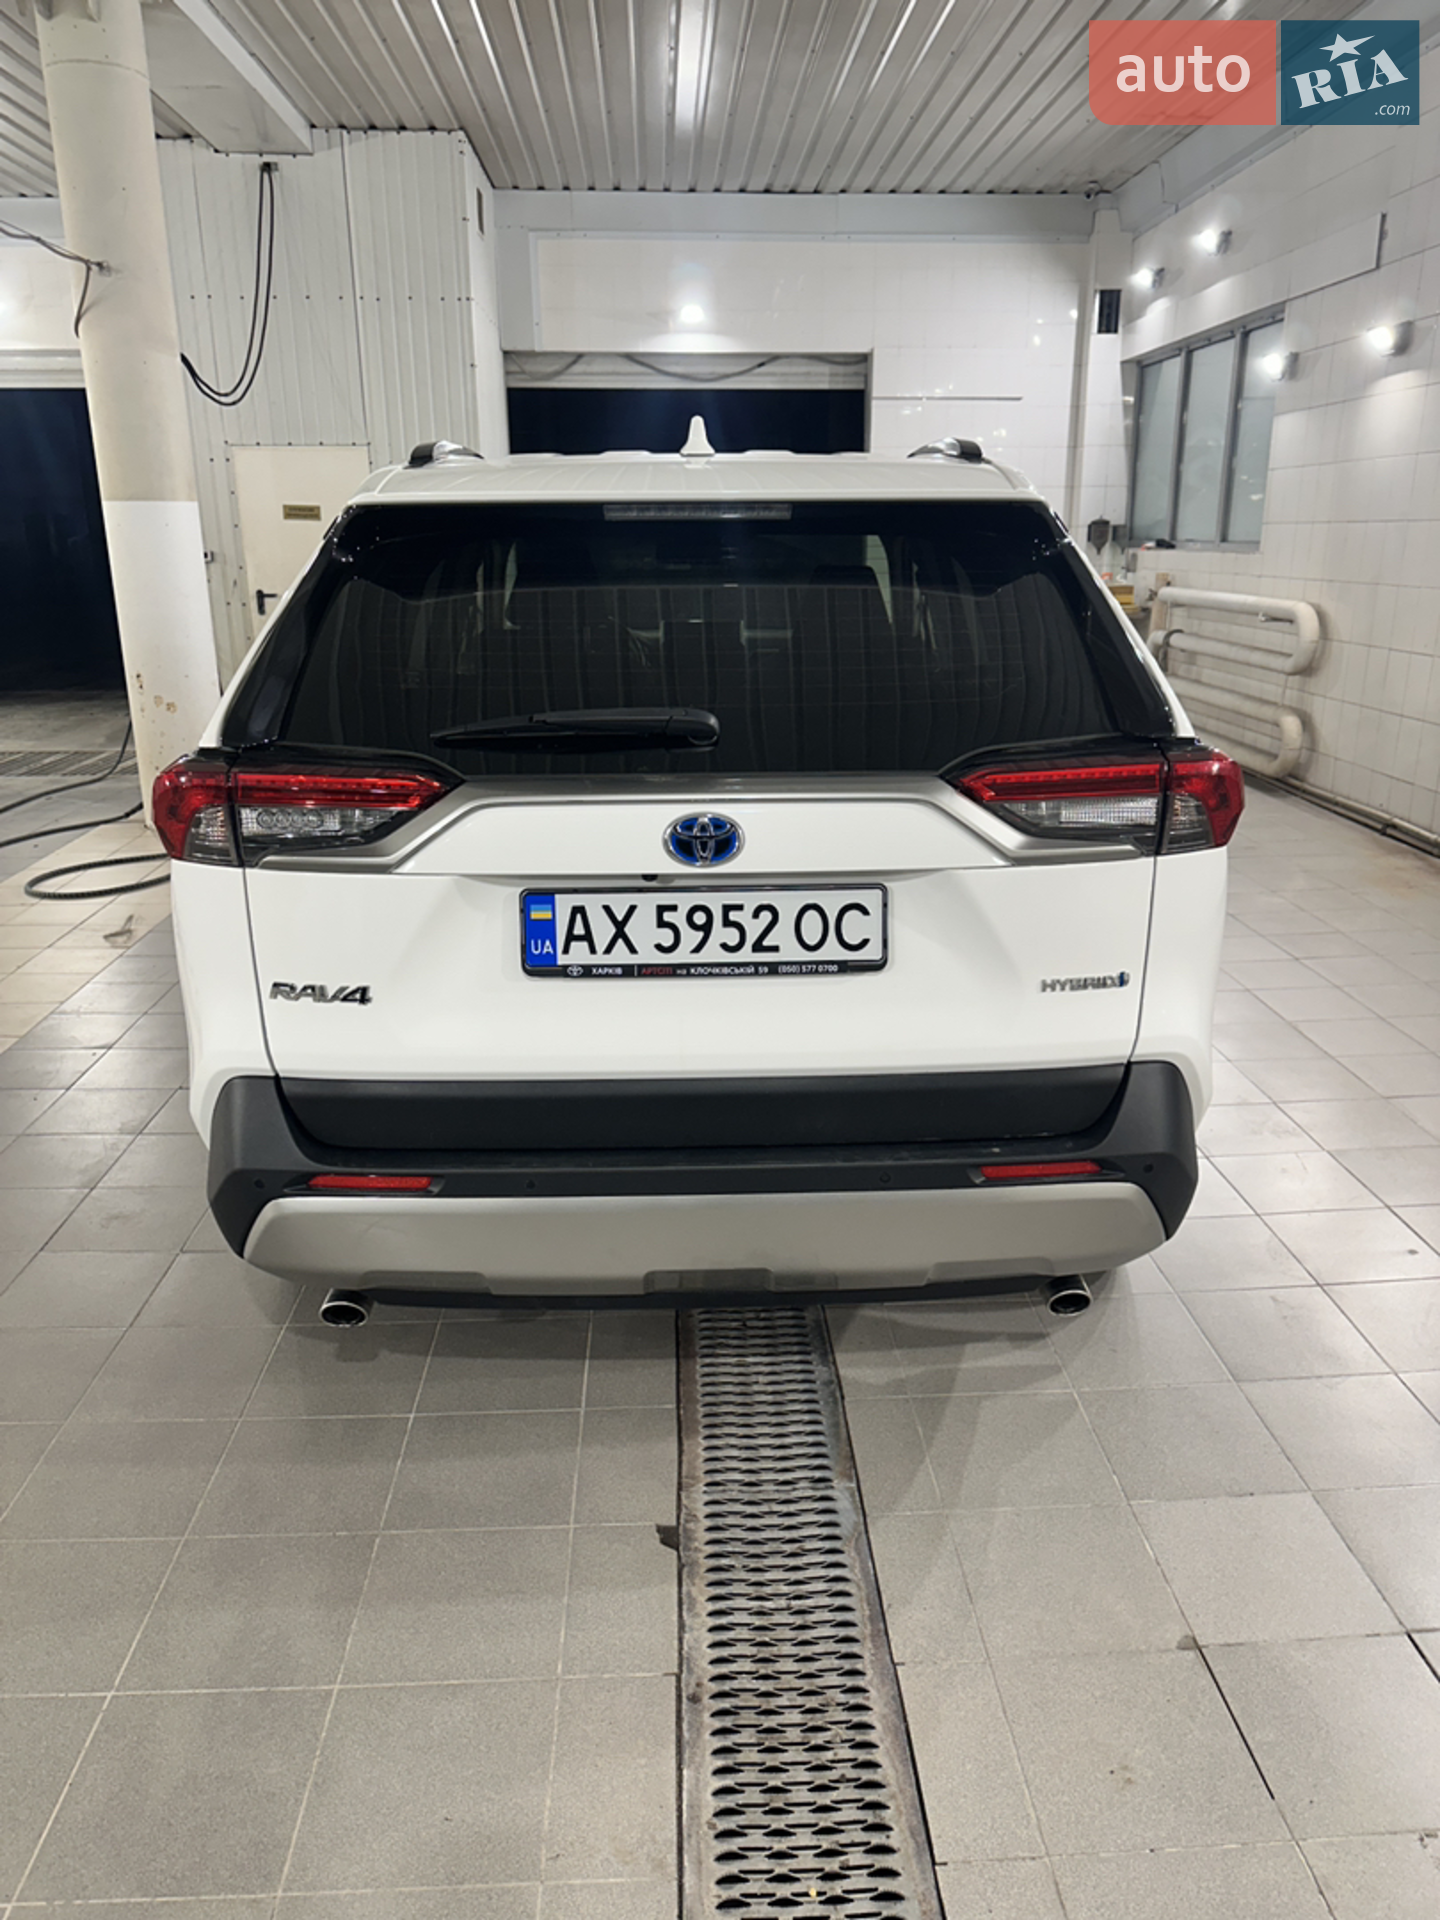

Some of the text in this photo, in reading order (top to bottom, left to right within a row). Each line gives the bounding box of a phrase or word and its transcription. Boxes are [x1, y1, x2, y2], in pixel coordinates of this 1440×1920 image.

[561, 902, 872, 955] AX 5952 OC
[530, 939, 554, 955] UA
[801, 964, 817, 973] 577
[817, 964, 839, 973] 0700
[1040, 976, 1118, 992] HYBRID
[269, 981, 373, 1006] RAV4
